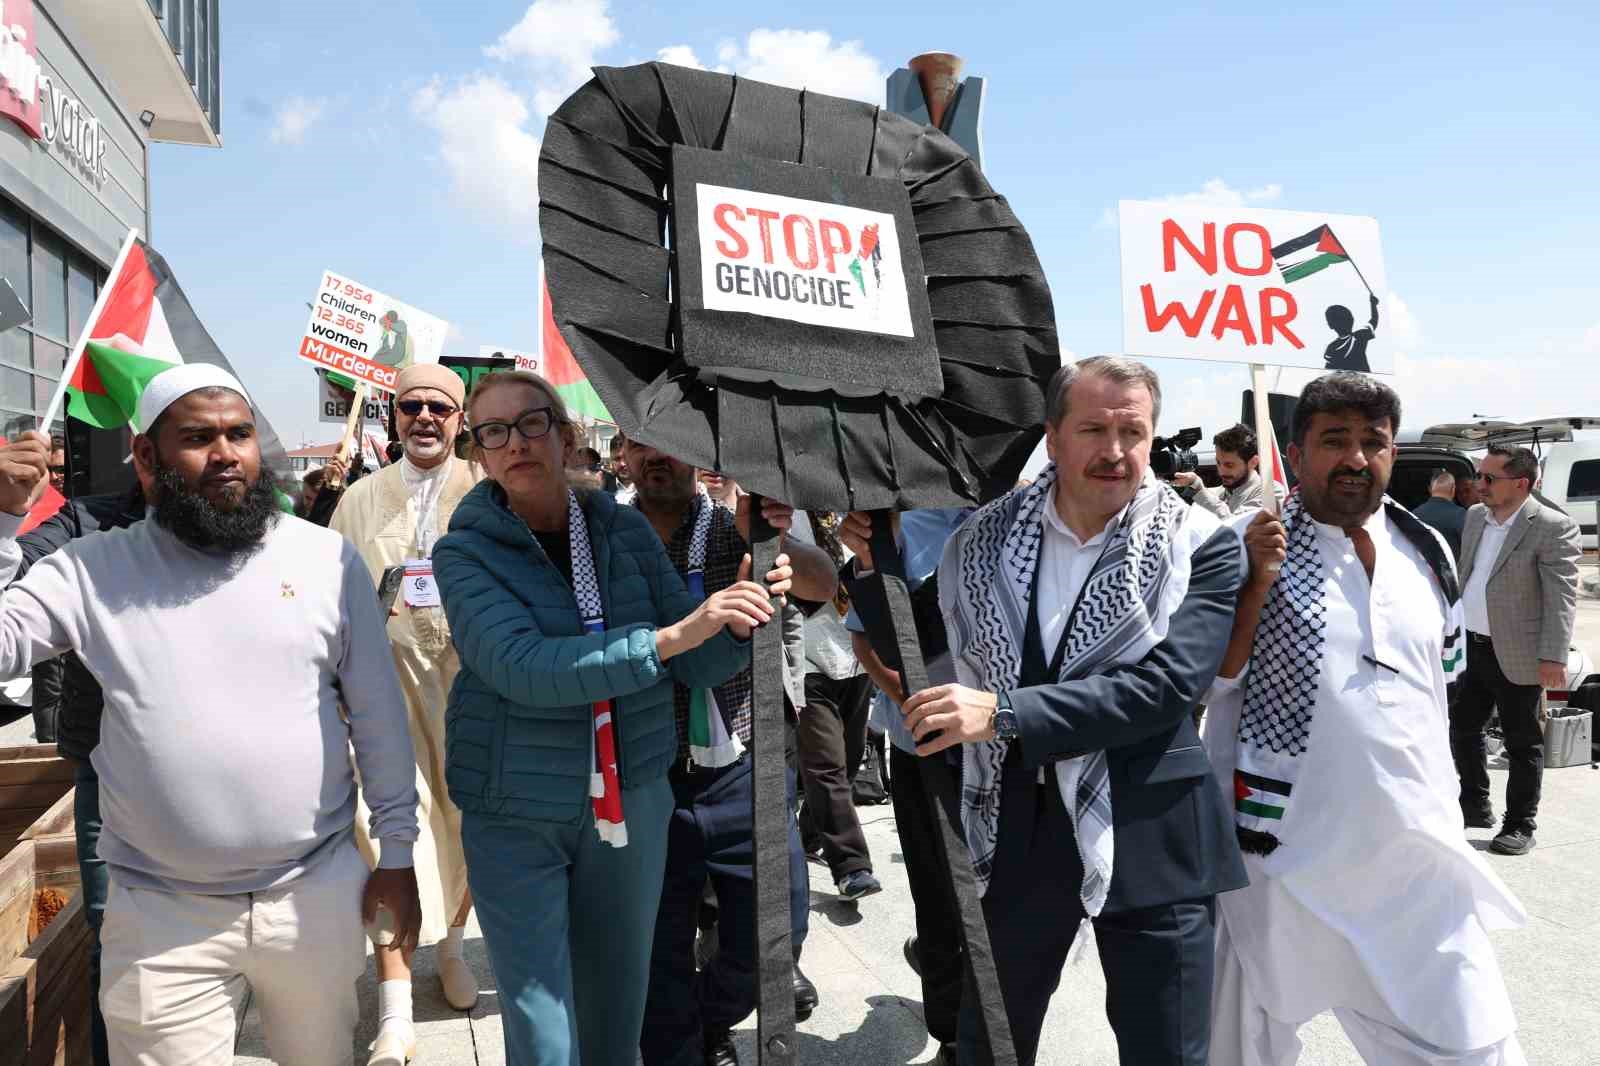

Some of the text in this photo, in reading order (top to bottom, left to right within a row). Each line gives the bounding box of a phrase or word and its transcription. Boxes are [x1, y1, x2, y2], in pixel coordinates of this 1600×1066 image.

[713, 203, 852, 273] STOP
[1162, 218, 1273, 276] NO
[320, 292, 377, 324] Children
[326, 275, 374, 304] 17.954
[715, 262, 854, 309] GENOCIDE
[312, 322, 368, 353] women
[317, 305, 365, 335] 12.365
[1140, 283, 1305, 349] WAR
[306, 339, 397, 385] Murdered
